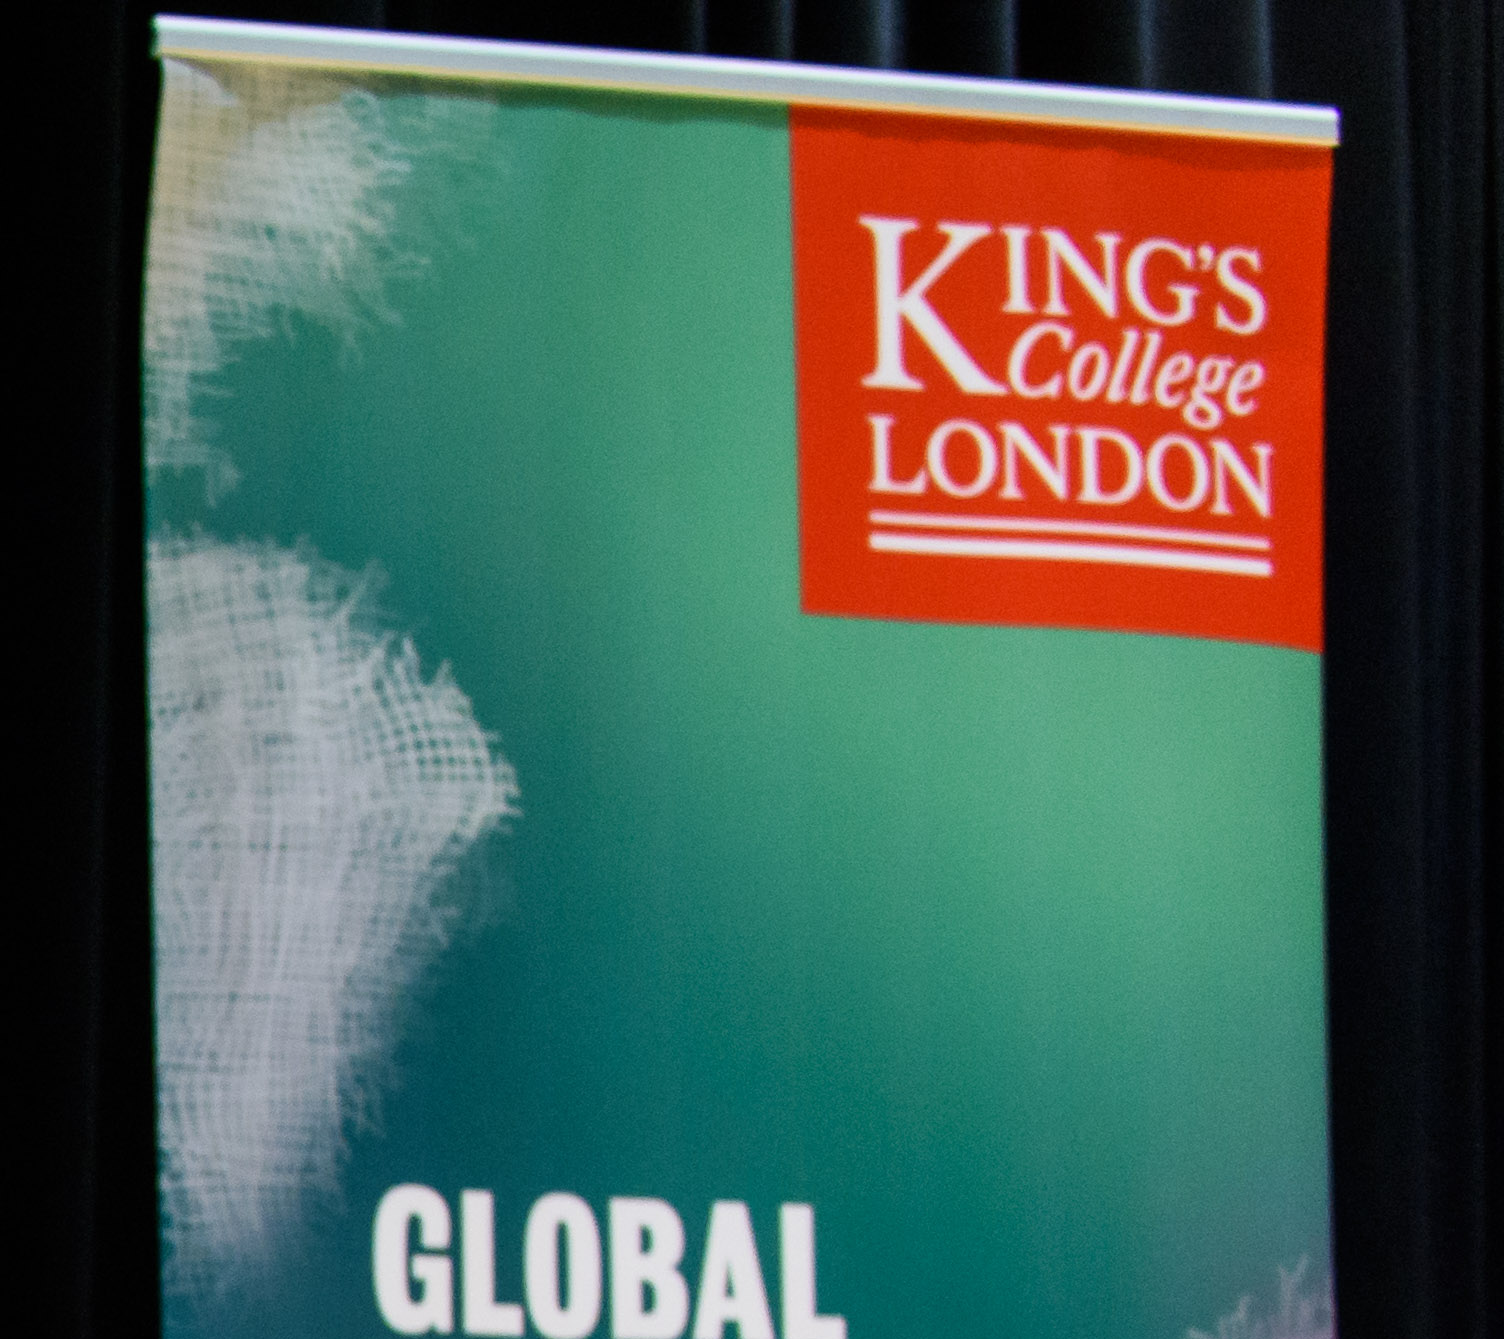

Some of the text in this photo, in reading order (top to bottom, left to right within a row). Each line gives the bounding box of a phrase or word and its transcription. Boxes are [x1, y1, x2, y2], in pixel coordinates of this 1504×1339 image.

[859, 216, 1267, 395] KING'S
[1007, 321, 1265, 430] College
[867, 414, 1274, 518] LONDON
